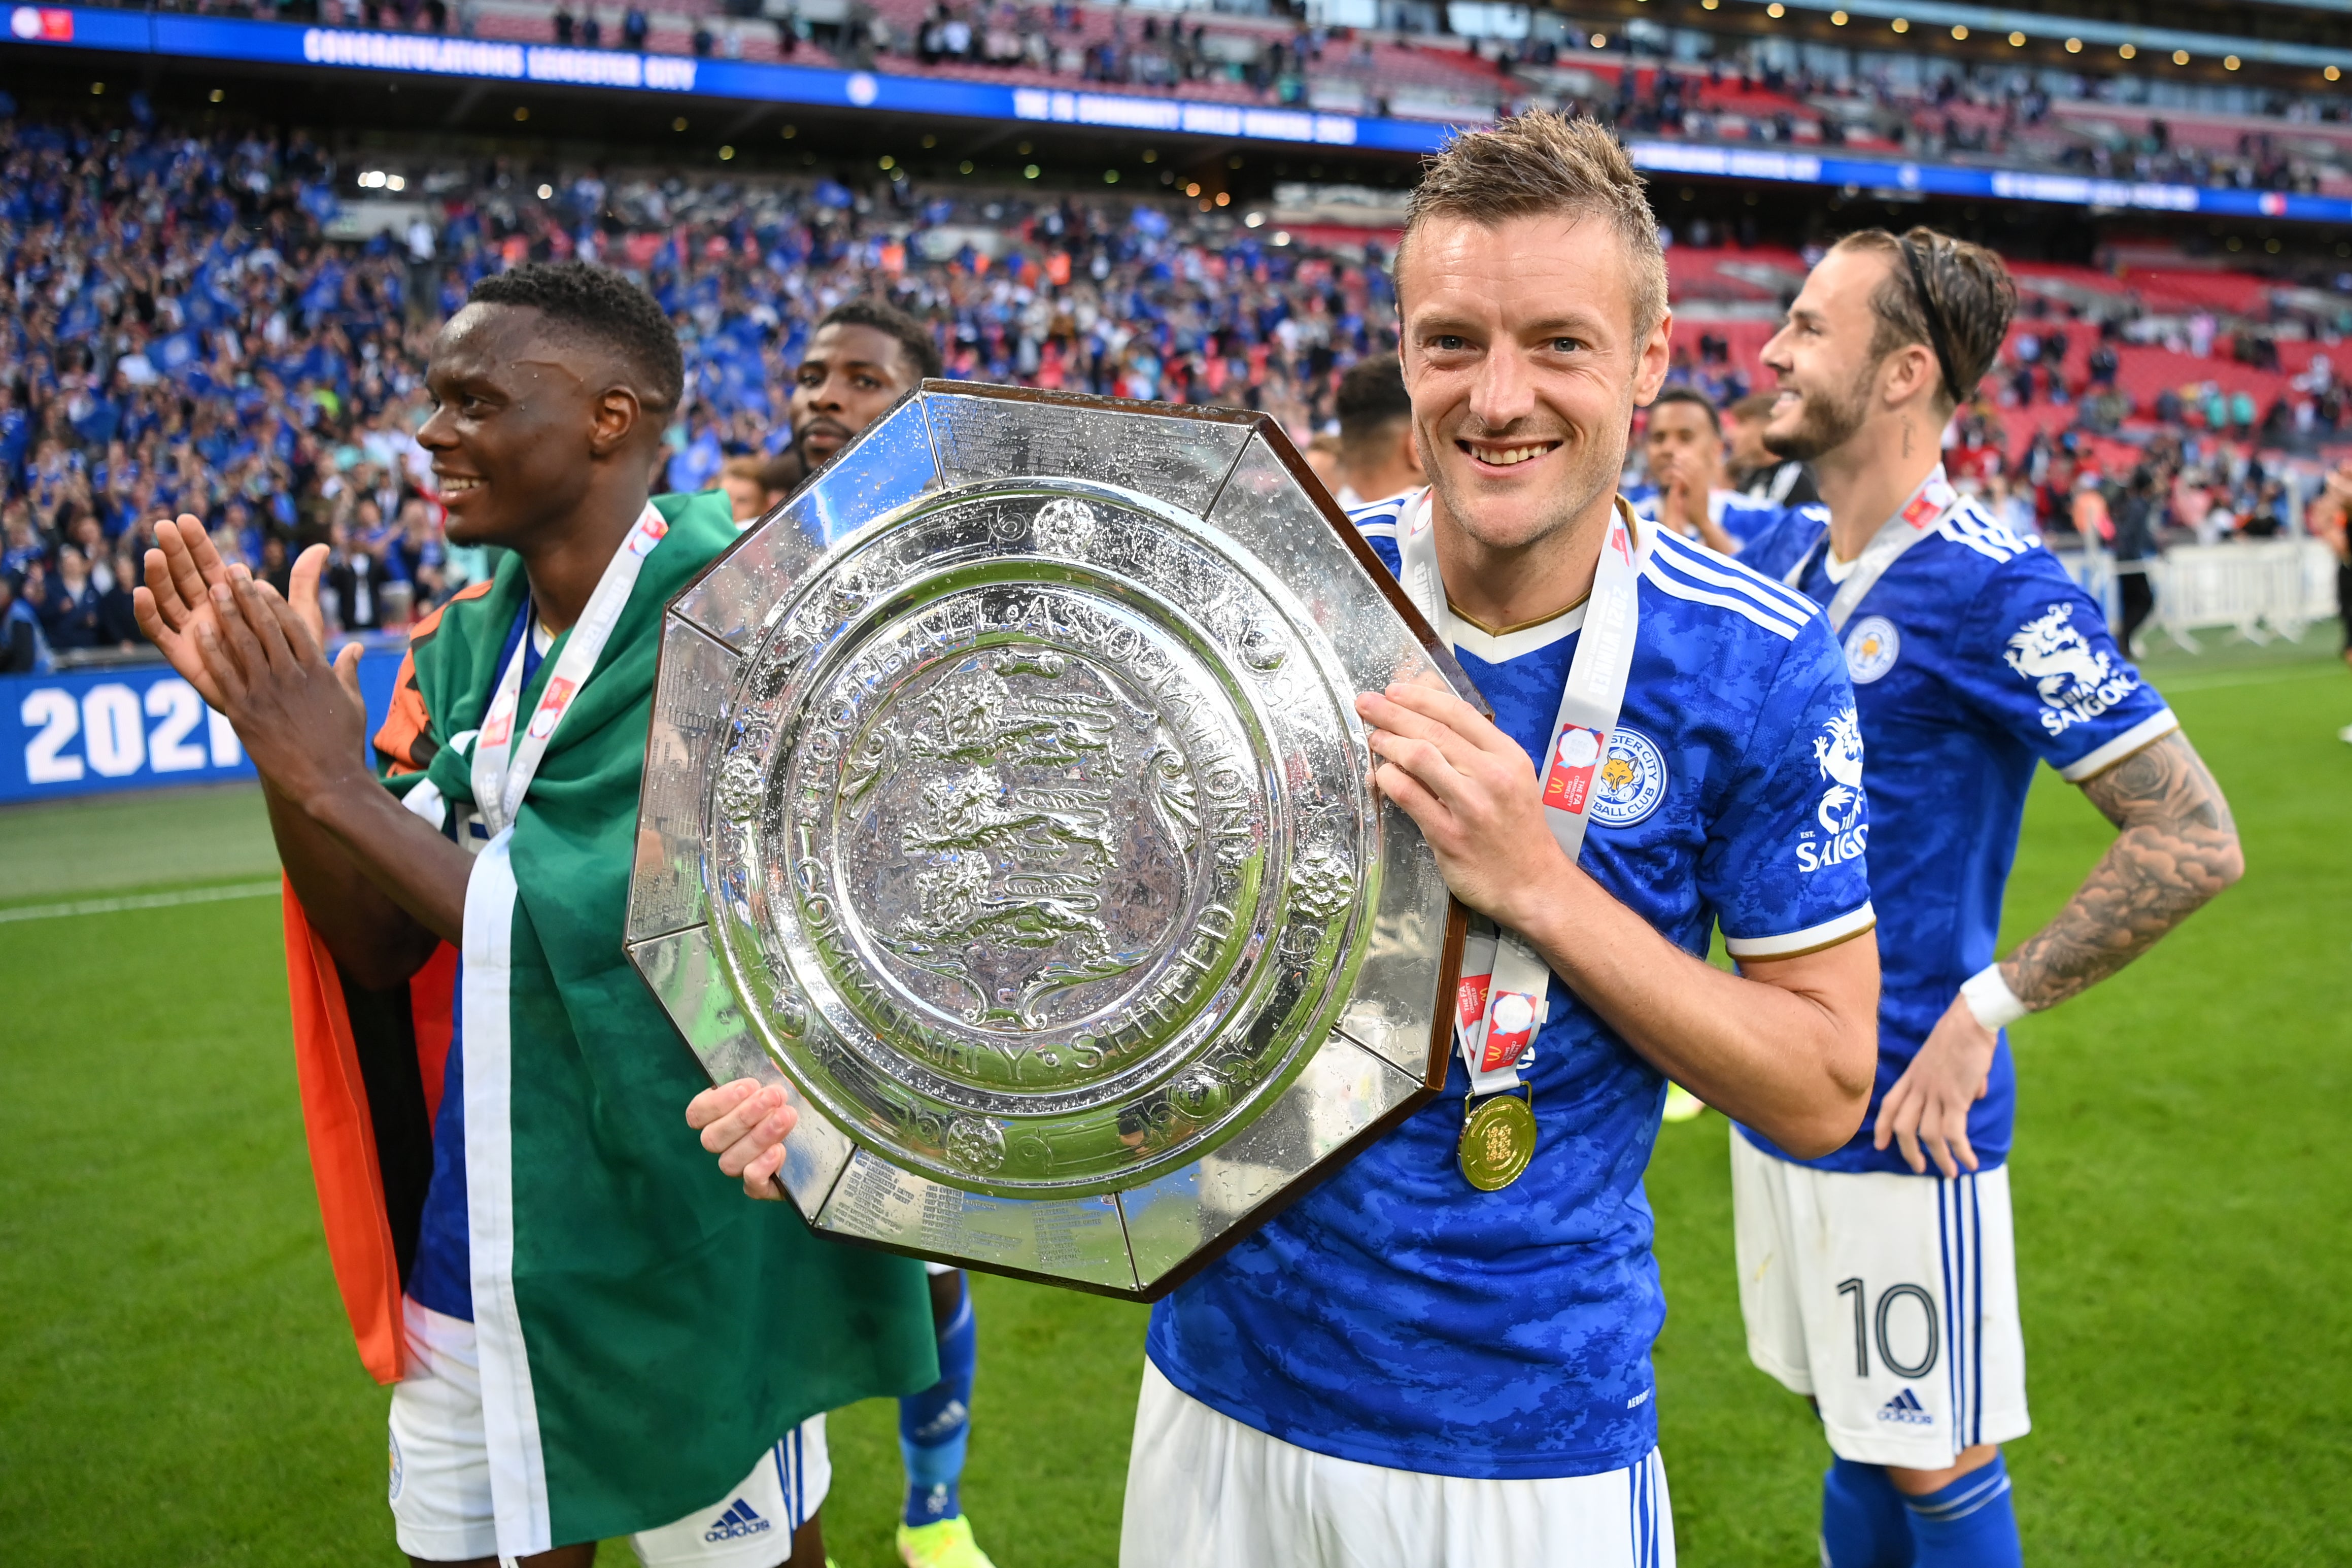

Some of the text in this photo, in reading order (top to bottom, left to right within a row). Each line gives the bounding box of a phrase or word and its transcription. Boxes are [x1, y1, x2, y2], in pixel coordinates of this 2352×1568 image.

[1588, 585, 1629, 696] 2021 WINNER
[2040, 673, 2140, 737] SAIGON
[20, 678, 242, 785] 2021
[1642, 751, 1657, 781] CITY
[1563, 780, 1573, 799] SHIELD
[1567, 775, 1580, 807] COMMUNITY
[1573, 780, 1585, 805] THE FA
[1627, 787, 1654, 814] CLUB
[1800, 831, 1816, 839] EST.
[796, 856, 1034, 1080] COMMUNITY
[1071, 904, 1235, 1070] SHIELD
[1459, 985, 1470, 1012] THE FA
[1465, 982, 1475, 1013] COMMUNITY
[857, 1189, 883, 1206] LIVERPOOL
[860, 1183, 885, 1200] LIVERPOOL
[892, 1193, 910, 1206] FOREST
[938, 1195, 962, 1204] EVERTON
[939, 1187, 963, 1197] EVERTON
[1837, 1277, 1939, 1378] 10
[1877, 1408, 1933, 1424] adidas
[705, 1519, 771, 1542] adidas
